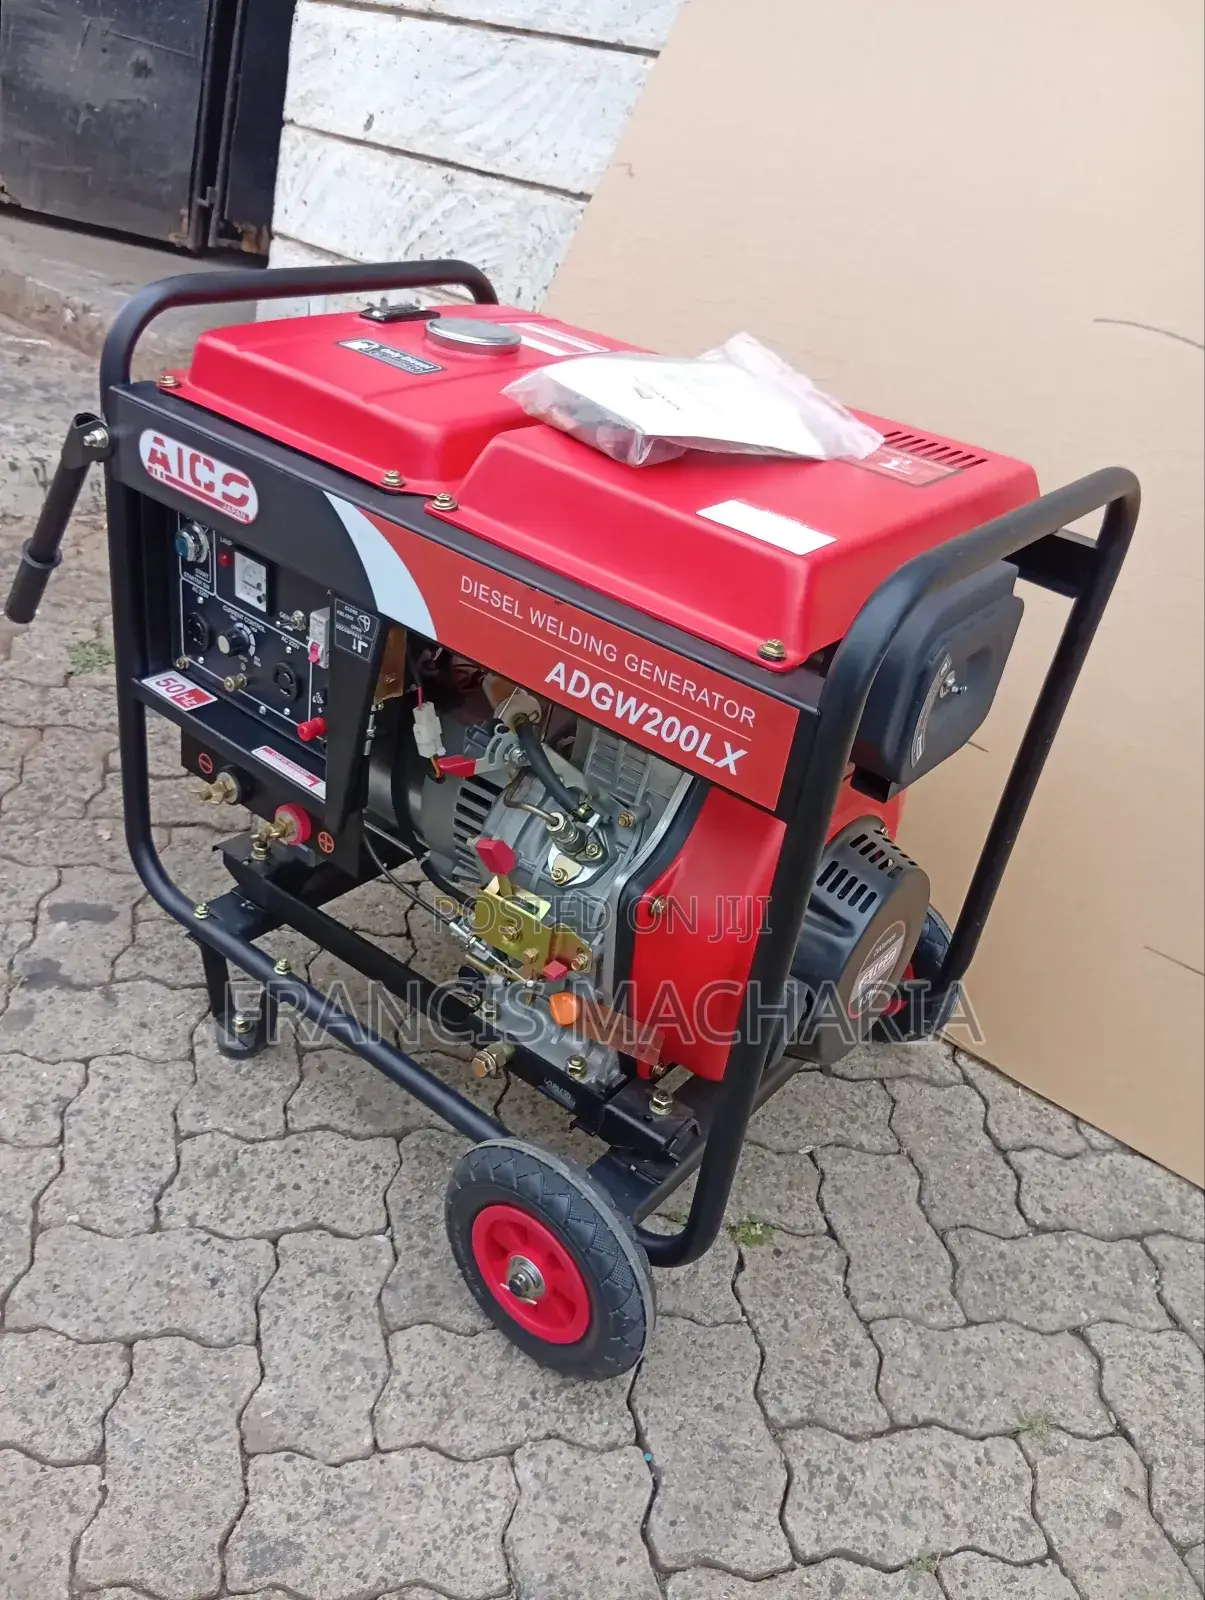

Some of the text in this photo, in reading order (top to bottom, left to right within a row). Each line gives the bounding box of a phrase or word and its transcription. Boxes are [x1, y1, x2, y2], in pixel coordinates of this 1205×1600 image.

[222, 604, 244, 620] CURRENT
[243, 616, 266, 633] CONTROL
[460, 575, 757, 729] DIESEL WELDING GENERATOR
[544, 661, 748, 776] ADGW200LX
